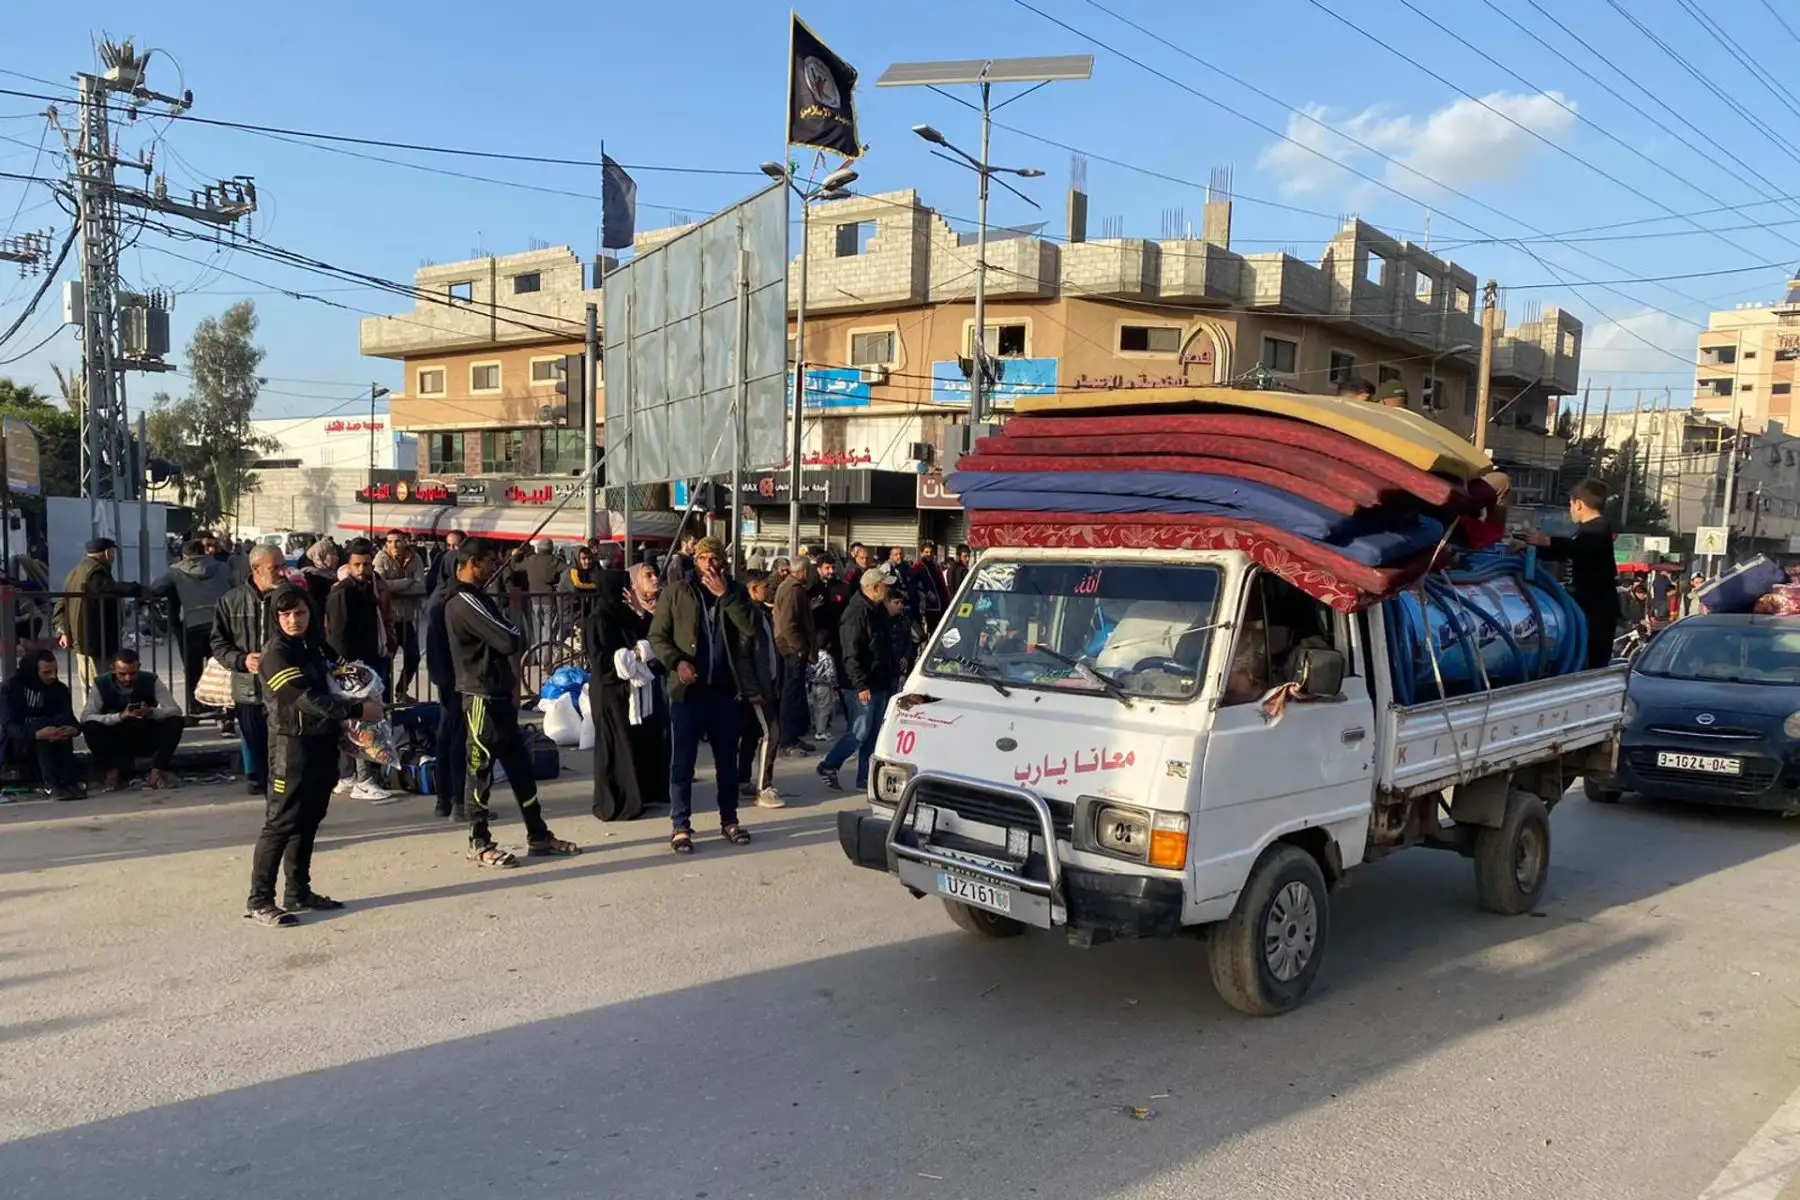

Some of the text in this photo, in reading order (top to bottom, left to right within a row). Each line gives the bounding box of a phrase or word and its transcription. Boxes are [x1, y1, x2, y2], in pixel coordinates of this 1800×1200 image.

[1074, 569, 1103, 594] الله
[895, 729, 916, 756] 10
[1074, 747, 1135, 774] معانا
[948, 875, 995, 906] UZ161
